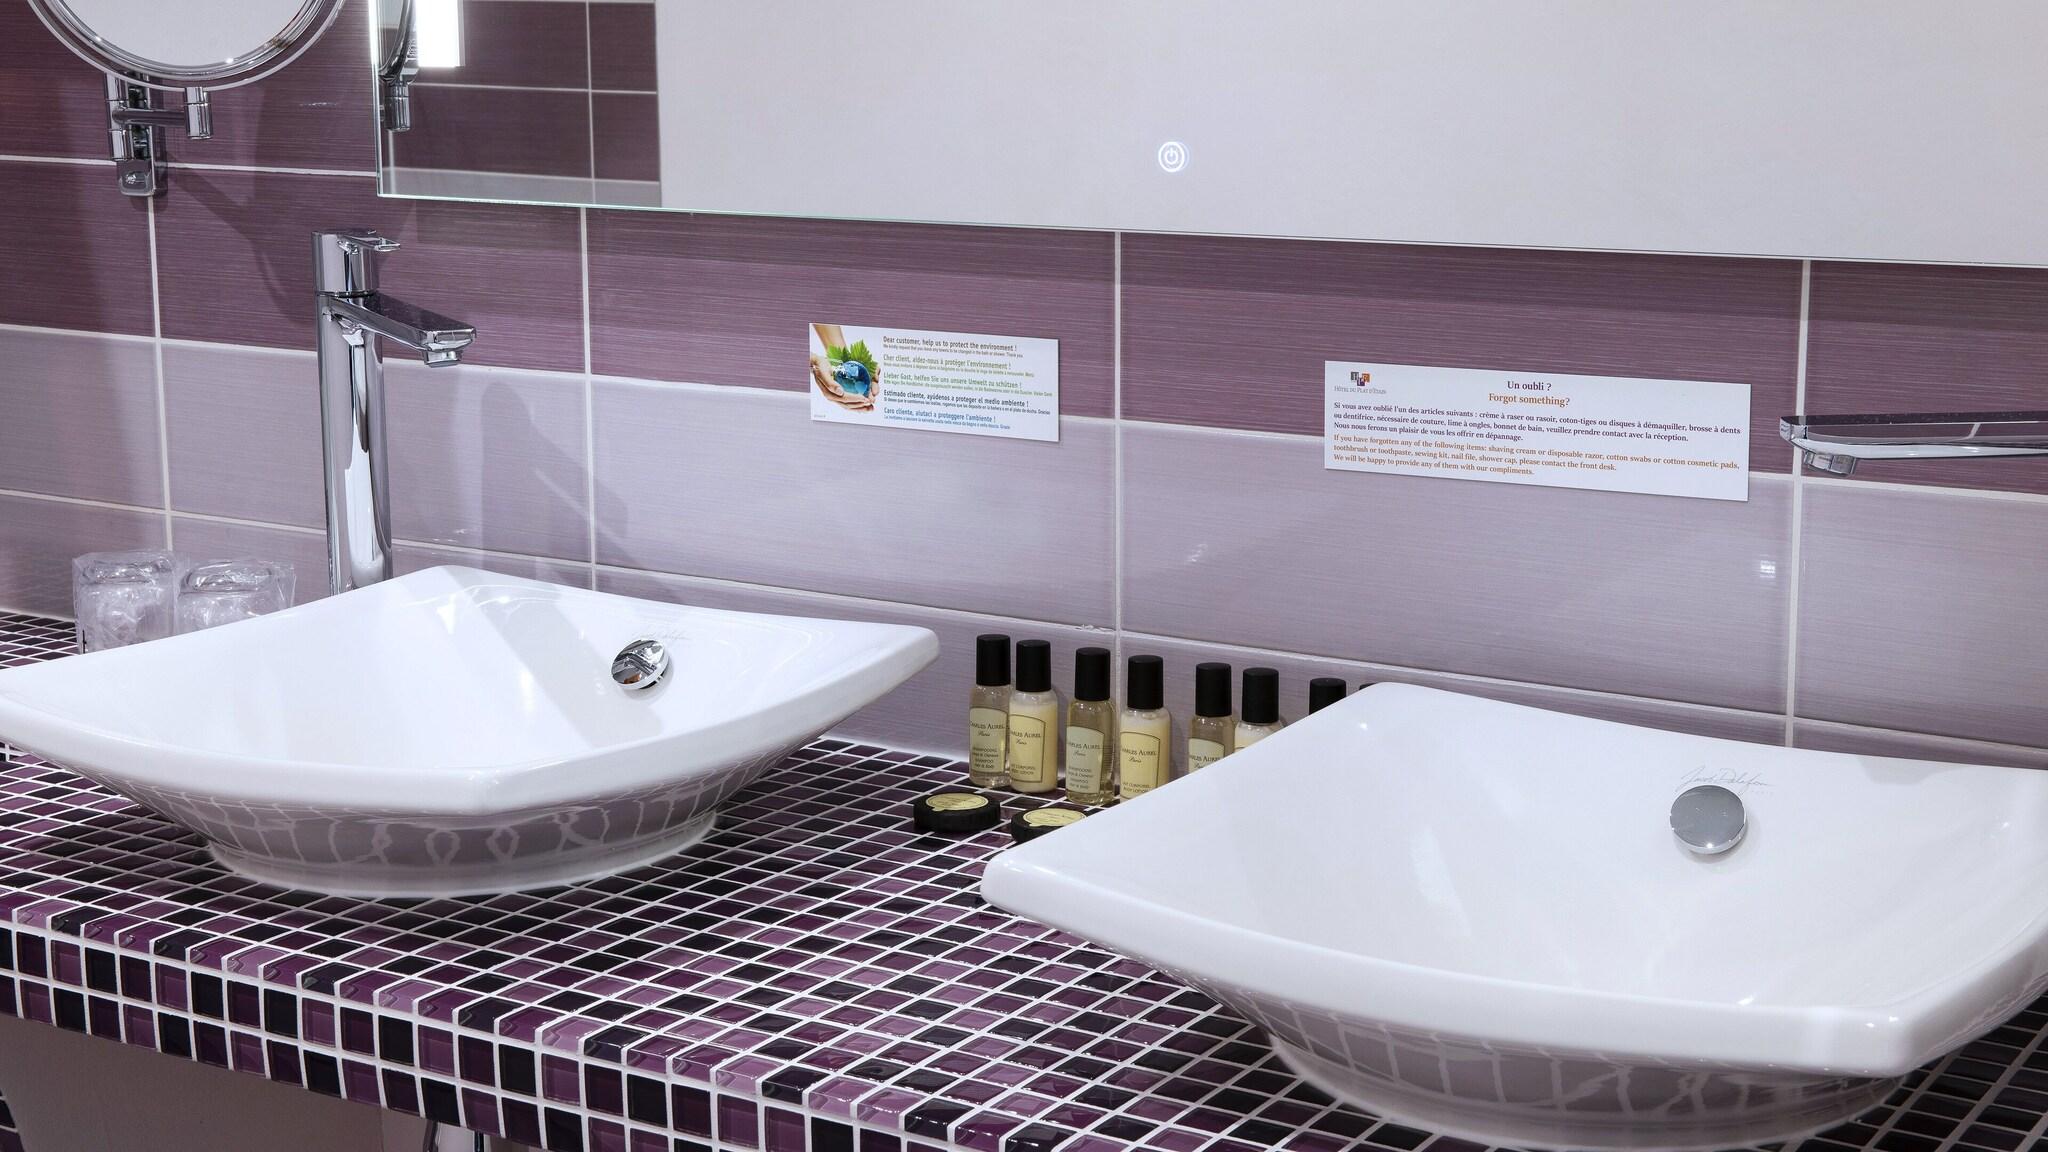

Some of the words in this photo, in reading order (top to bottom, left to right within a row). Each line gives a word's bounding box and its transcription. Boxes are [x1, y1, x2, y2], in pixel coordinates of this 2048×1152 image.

[922, 339, 934, 347] help
[950, 341, 969, 350] protect
[980, 343, 1013, 351] environment
[1508, 381, 1520, 389] Un
[1522, 381, 1544, 391] oubli
[884, 389, 906, 397] Estimado
[907, 391, 926, 399] cliente,
[956, 396, 977, 404] proteger
[1001, 399, 1025, 407] ambiente
[1489, 393, 1517, 405] Forgot
[1519, 394, 1570, 408] something?
[1343, 412, 1376, 421] dentifrice,
[1377, 415, 1410, 423] nécessaire
[1448, 419, 1463, 427] lime
[1469, 421, 1492, 430] ongles,
[1494, 422, 1517, 430] bonnet
[1528, 424, 1545, 432] bain,
[1546, 425, 1572, 434] veuillez
[1573, 427, 1601, 437] prendre
[1602, 430, 1627, 438] contact
[1654, 432, 1688, 443] réception.
[1421, 407, 1445, 415] articles
[1446, 409, 1474, 417] suivants
[1479, 411, 1500, 419] crème
[1536, 415, 1558, 423] rasoir,
[1559, 416, 1597, 427] coton-tiges
[1609, 419, 1636, 429] disques
[1643, 421, 1688, 433] démaquiller,
[1689, 424, 1713, 432] brosse
[1720, 426, 1741, 434] dents
[1399, 426, 1419, 435] plaisir
[1485, 432, 1523, 442] dépannage.
[1334, 433, 1339, 441] If
[1370, 437, 1399, 446] forgotten
[1414, 439, 1421, 447] of
[1434, 441, 1465, 451] following
[1467, 443, 1487, 451] items:
[1489, 445, 1515, 455] shaving
[1547, 449, 1583, 460] disposable
[1630, 455, 1652, 463] swabs
[1687, 458, 1719, 467] cosmetic
[1721, 461, 1740, 471] pads,
[1334, 444, 1369, 453] toothbrush
[1378, 447, 1413, 458] toothpaste,
[1415, 451, 1438, 459] sewing
[1439, 451, 1450, 459] kit,
[1451, 452, 1464, 460] nail
[1465, 453, 1478, 461] file,
[1479, 454, 1503, 463] shower
[1519, 457, 1540, 467] please
[1599, 463, 1616, 471] desk.
[1345, 454, 1357, 462] will
[1367, 456, 1386, 466] happy
[1395, 458, 1420, 468] provide
[1460, 463, 1475, 471] with
[1490, 465, 1534, 476] compliments.
